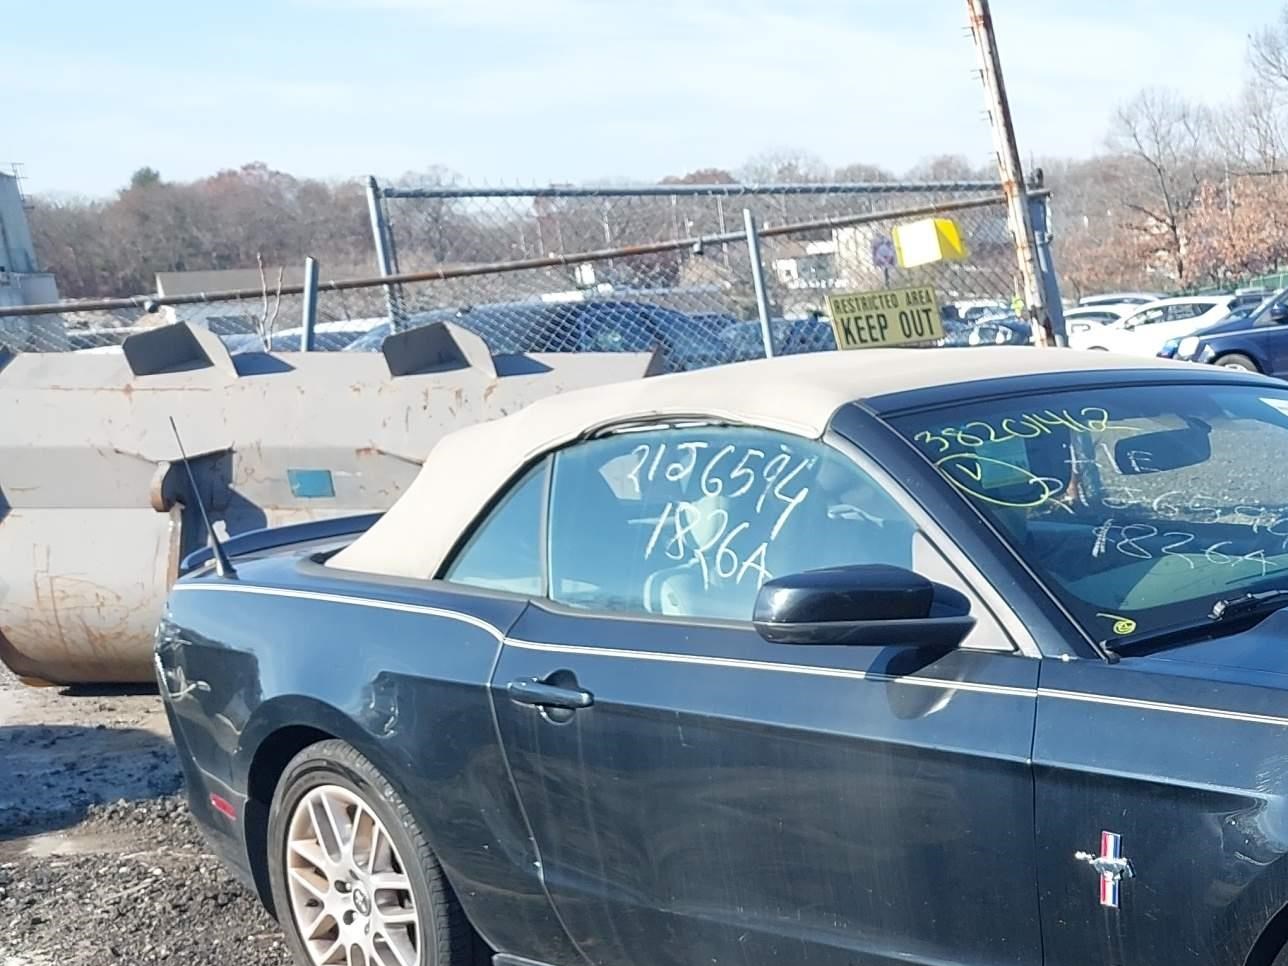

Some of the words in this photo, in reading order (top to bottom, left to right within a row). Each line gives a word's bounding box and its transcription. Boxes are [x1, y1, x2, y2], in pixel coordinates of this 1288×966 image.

[834, 293, 899, 314] RESTRICTED
[905, 290, 933, 305] AREA
[840, 312, 889, 345] KEEP
[900, 308, 933, 338] OUT
